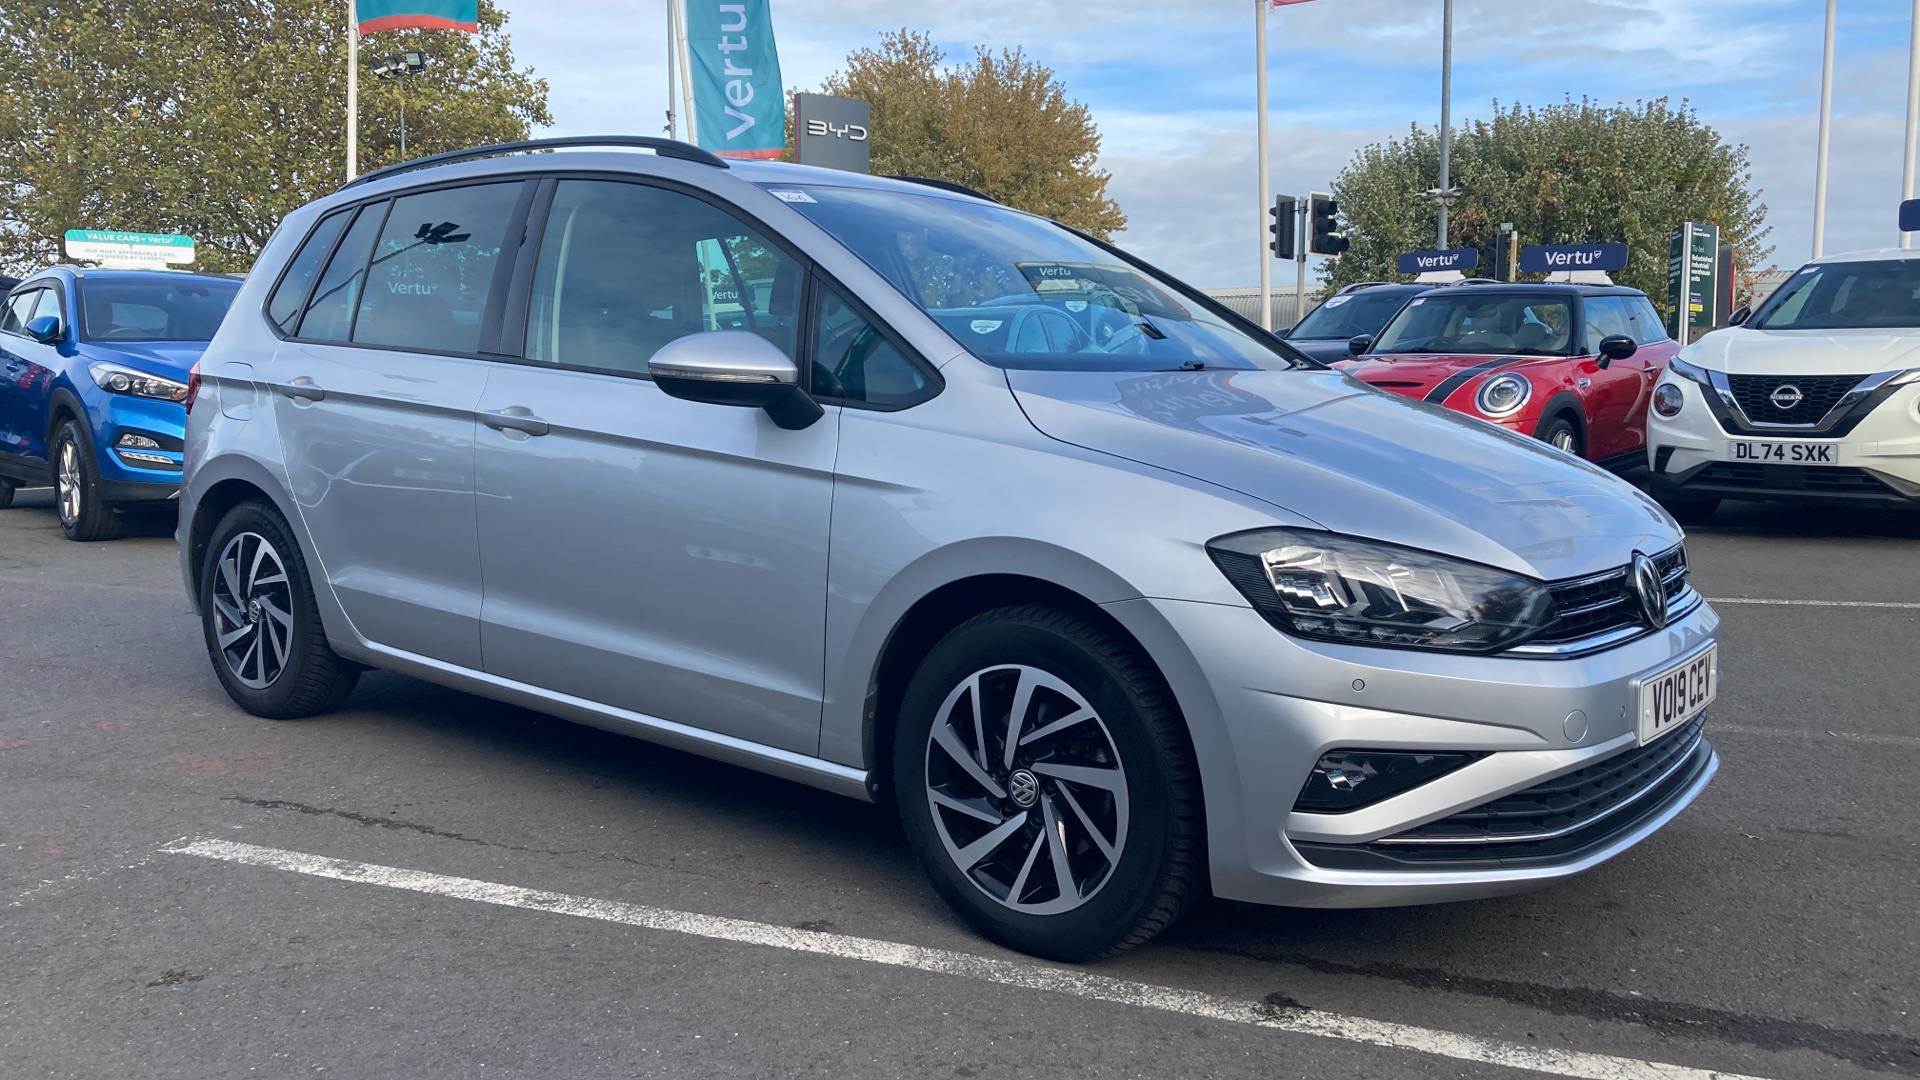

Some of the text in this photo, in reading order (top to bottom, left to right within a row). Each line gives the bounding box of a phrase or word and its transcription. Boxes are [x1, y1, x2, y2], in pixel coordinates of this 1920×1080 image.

[808, 119, 867, 140] BYD
[117, 234, 140, 242] CARS
[1417, 254, 1453, 268] Vertu
[1545, 251, 1593, 265] Vertu
[1039, 266, 1071, 276] Vertu
[387, 282, 431, 295] Vertu
[1736, 442, 1830, 462] DL74 SXK
[1653, 670, 1686, 728] VO19
